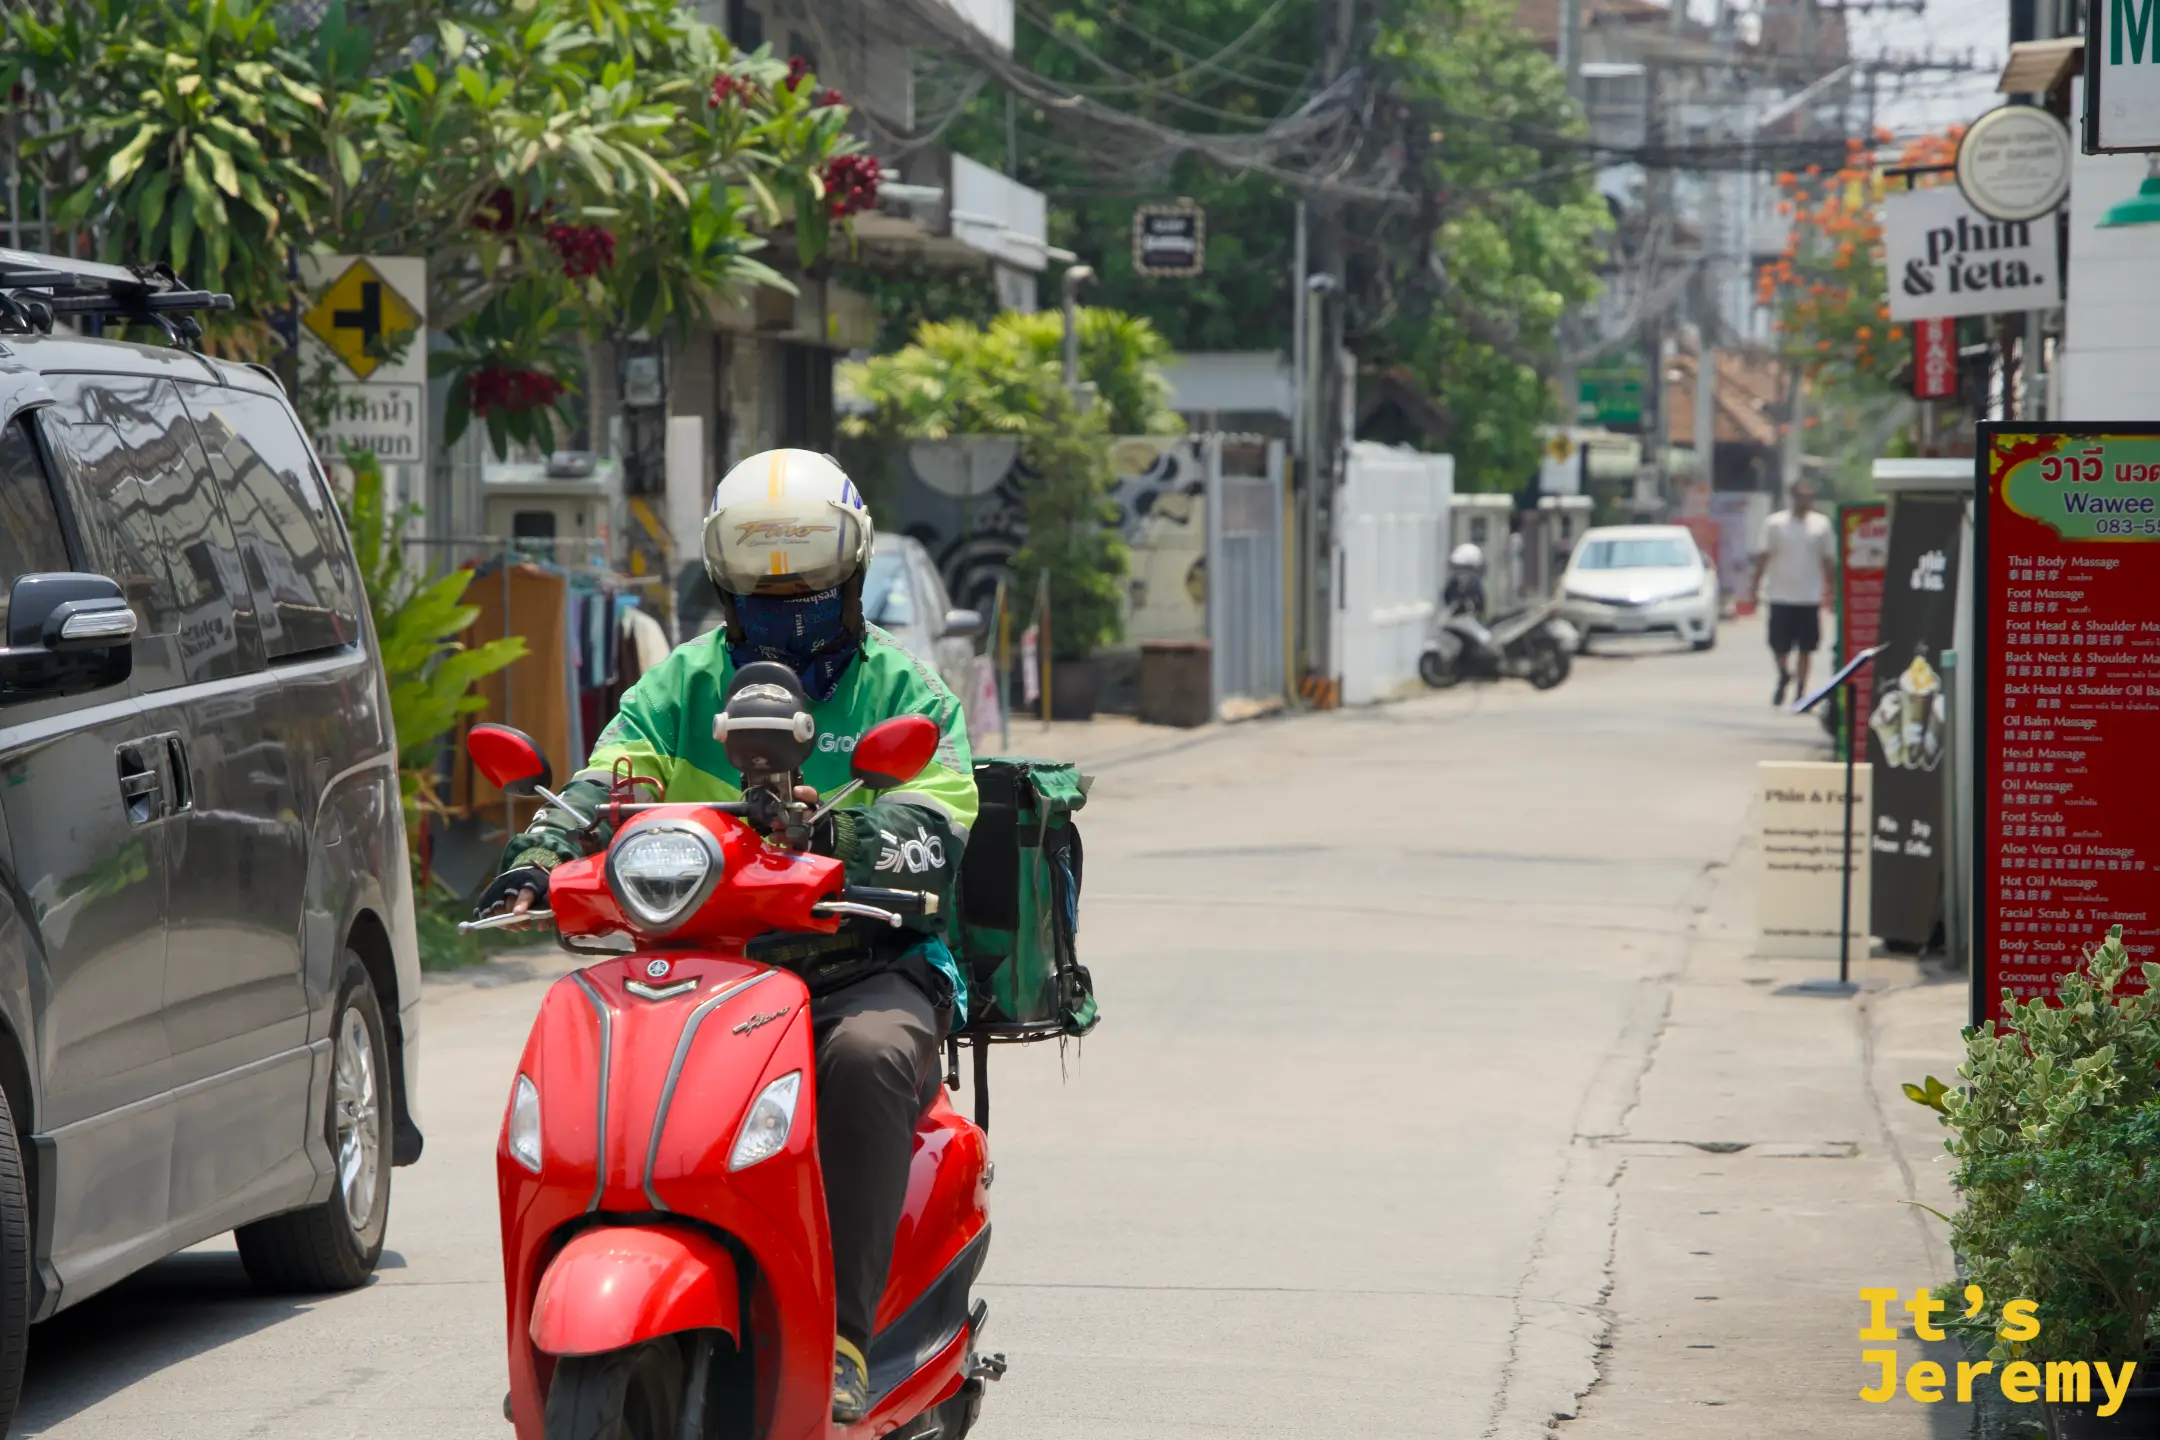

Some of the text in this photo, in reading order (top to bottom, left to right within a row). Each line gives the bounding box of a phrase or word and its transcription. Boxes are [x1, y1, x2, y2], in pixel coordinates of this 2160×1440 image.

[1927, 215, 2031, 266] phin
[1903, 258, 1934, 296] &
[2041, 447, 2104, 482] วาวี
[2064, 492, 2154, 514] Wawee
[2008, 555, 2119, 570] Thai Body Massage
[2007, 588, 2084, 601] Foot Massage
[795, 614, 804, 636] rain
[2006, 620, 2031, 630] Foot
[2036, 620, 2066, 630] Head
[2071, 621, 2081, 630] &
[2085, 620, 2136, 631] Shoulder
[2005, 651, 2033, 662] Back
[2038, 652, 2067, 662] Neck
[2072, 653, 2082, 663] &
[2087, 652, 2137, 663] Shoulder
[2005, 683, 2030, 694] Back
[2033, 684, 2061, 694] Head
[2065, 685, 2074, 695] &
[2078, 684, 2123, 695] Shoulder
[2126, 685, 2142, 695] Oil
[2004, 715, 2097, 730] Oil Balm Massage
[818, 732, 863, 752] Gra
[2003, 747, 2086, 762] Head Massage
[2002, 779, 2073, 794] Oil Massage
[2002, 811, 2063, 822] Foot Scrub
[2001, 843, 2134, 859] Aloe Vera Oil Massage
[2000, 876, 2097, 890] Hot Oil Massage
[2000, 907, 2146, 920] Facial Scrub & Treatment
[2000, 939, 2028, 952] Body
[2033, 940, 2065, 950] Scrub
[1998, 971, 2046, 982] Coconut
